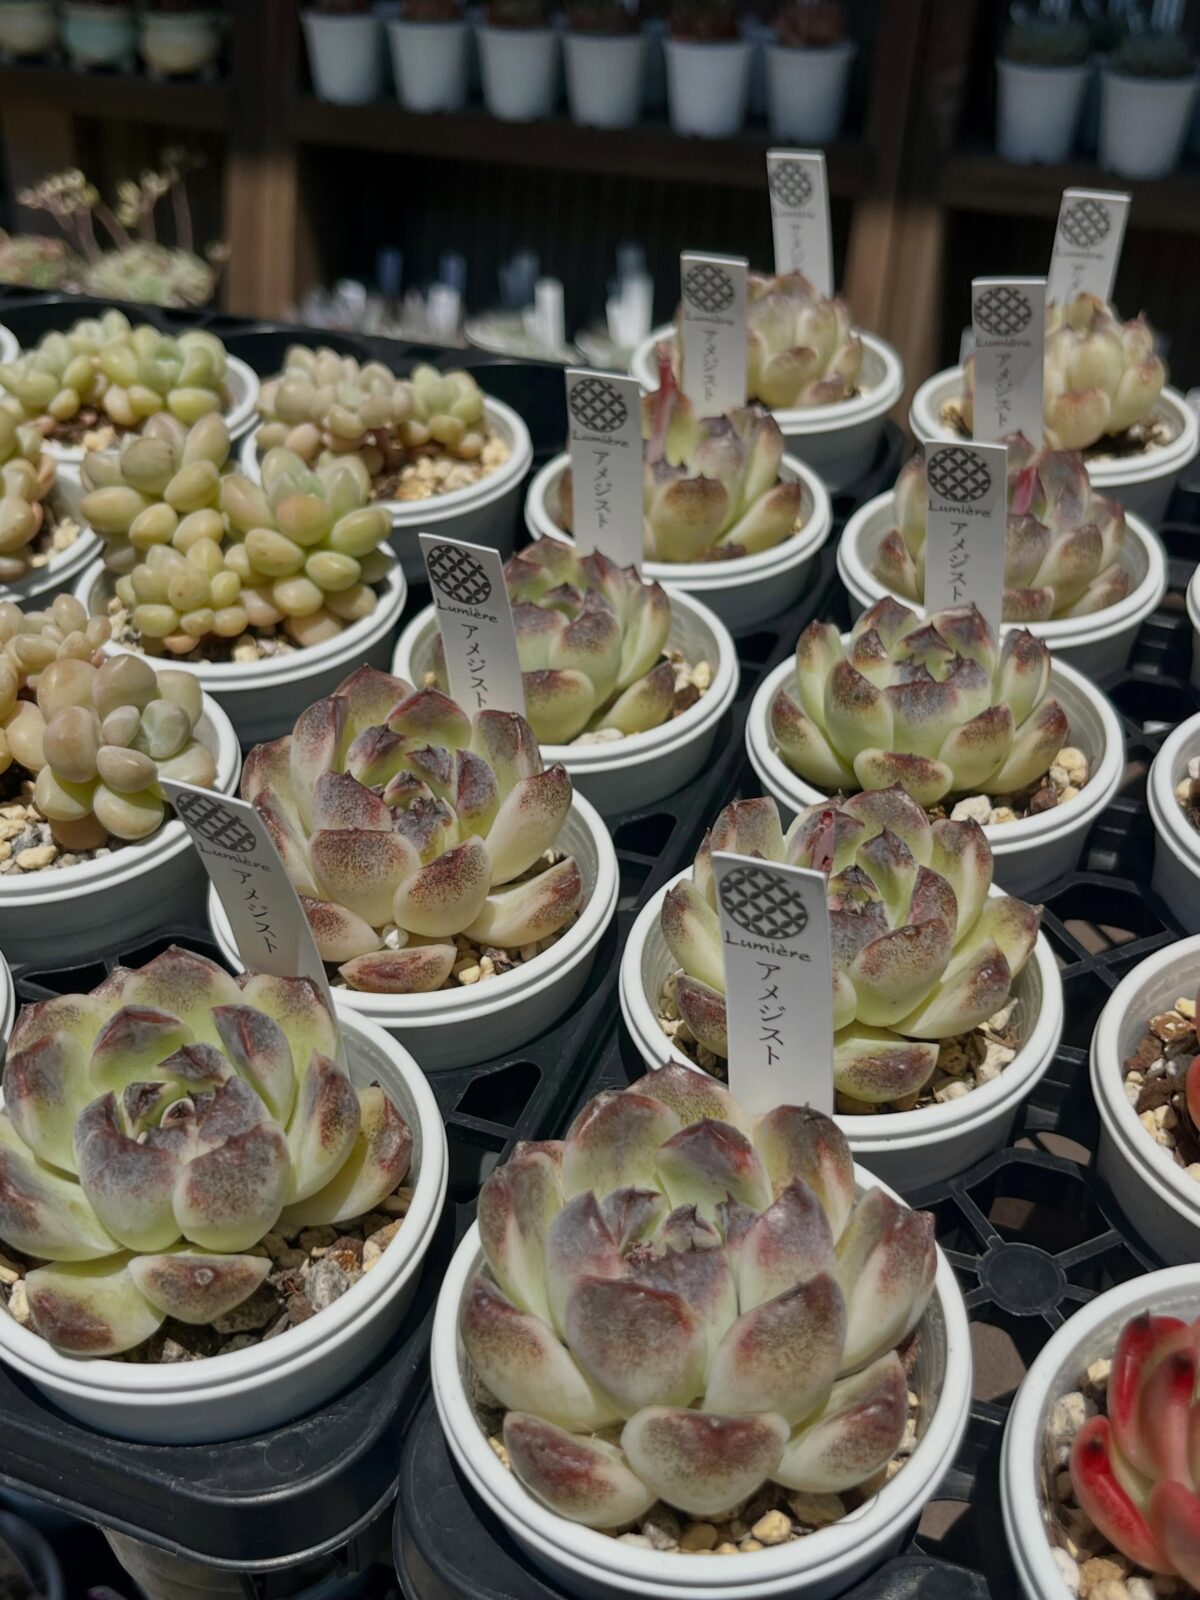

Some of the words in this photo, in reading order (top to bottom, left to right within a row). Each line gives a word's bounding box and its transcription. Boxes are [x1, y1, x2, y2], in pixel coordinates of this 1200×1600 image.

[592, 450, 612, 529] アメジスト
[928, 500, 991, 518] Lumière
[948, 521, 970, 602] アメジスト
[437, 598, 499, 624] Lumière
[461, 624, 489, 708] アメジスト
[199, 841, 272, 873] Lumière
[231, 868, 277, 954] アメジスト
[724, 931, 812, 962] Lumière
[756, 961, 786, 1065] アメジスト
